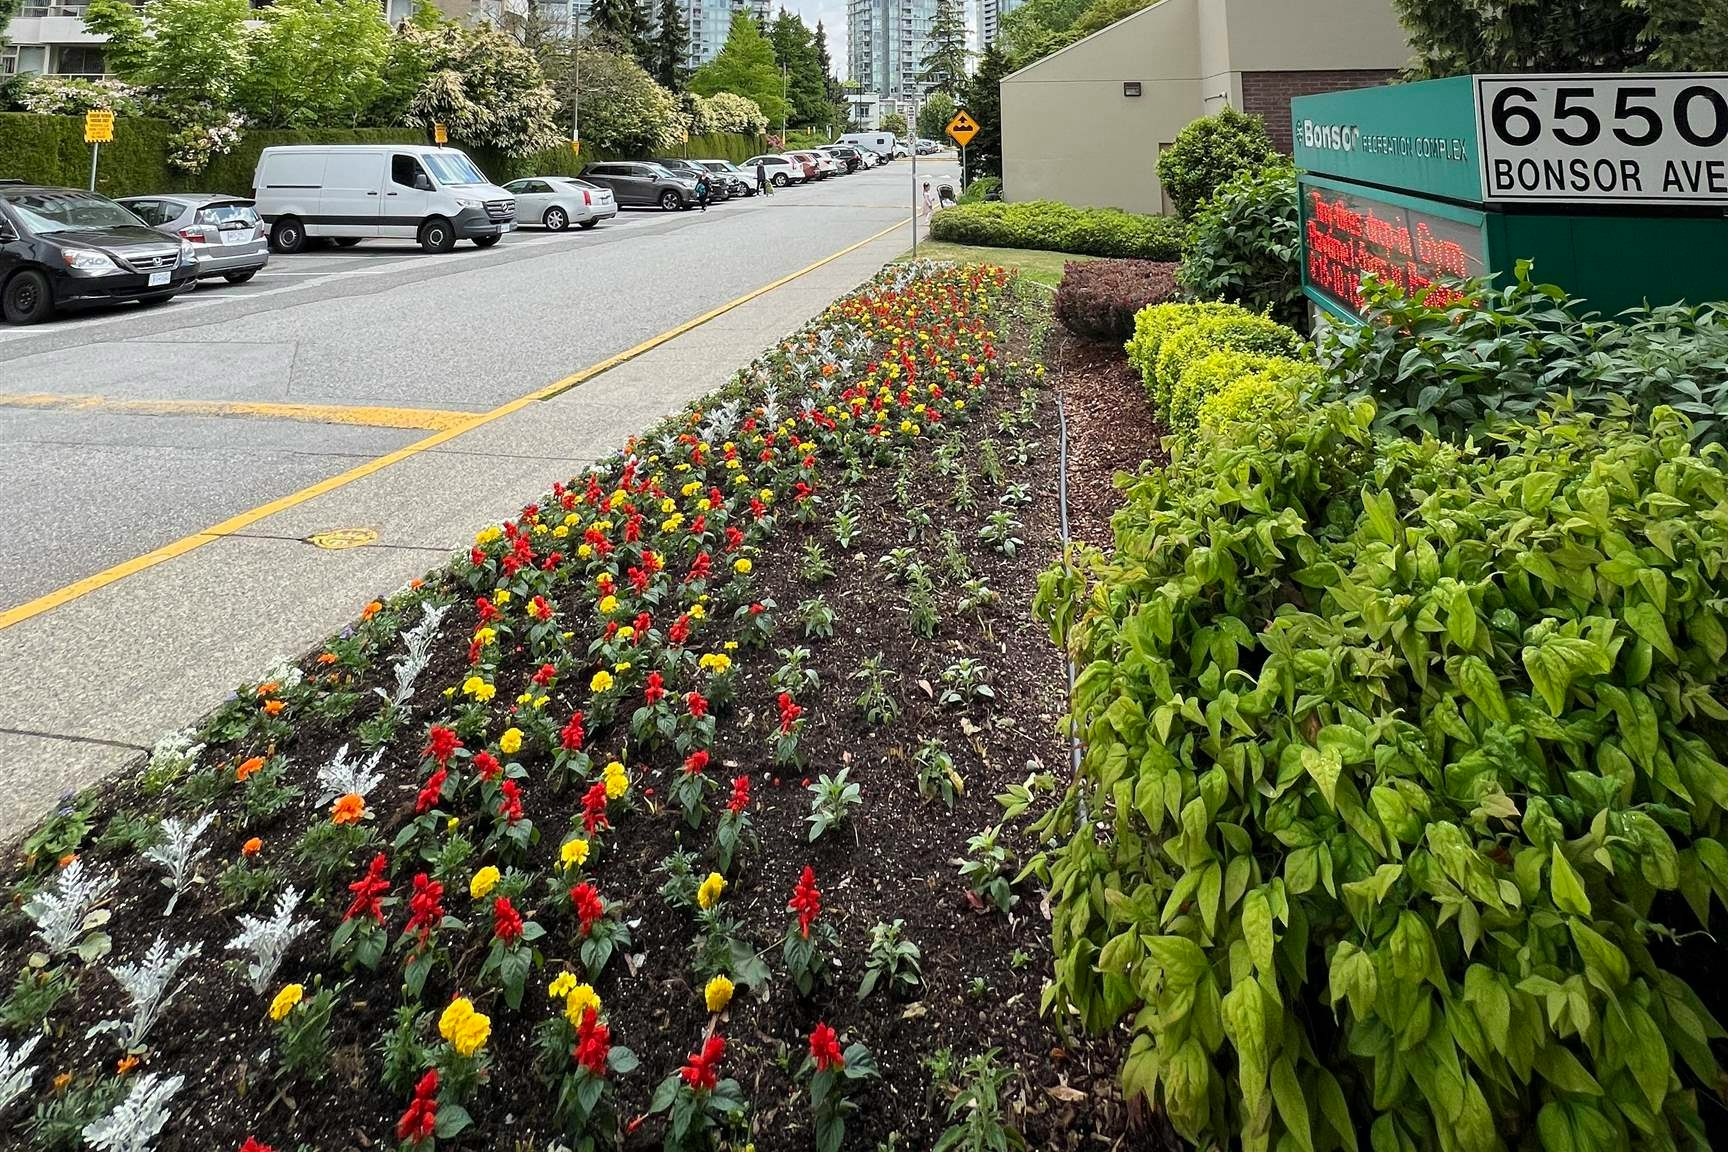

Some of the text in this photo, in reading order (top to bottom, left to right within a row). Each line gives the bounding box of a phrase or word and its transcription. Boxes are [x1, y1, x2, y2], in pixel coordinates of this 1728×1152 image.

[1492, 86, 1728, 147] 6550
[1303, 119, 1468, 161] Bonsor RECREATION COMPLEX
[1494, 158, 1728, 193] BONSOR AVE
